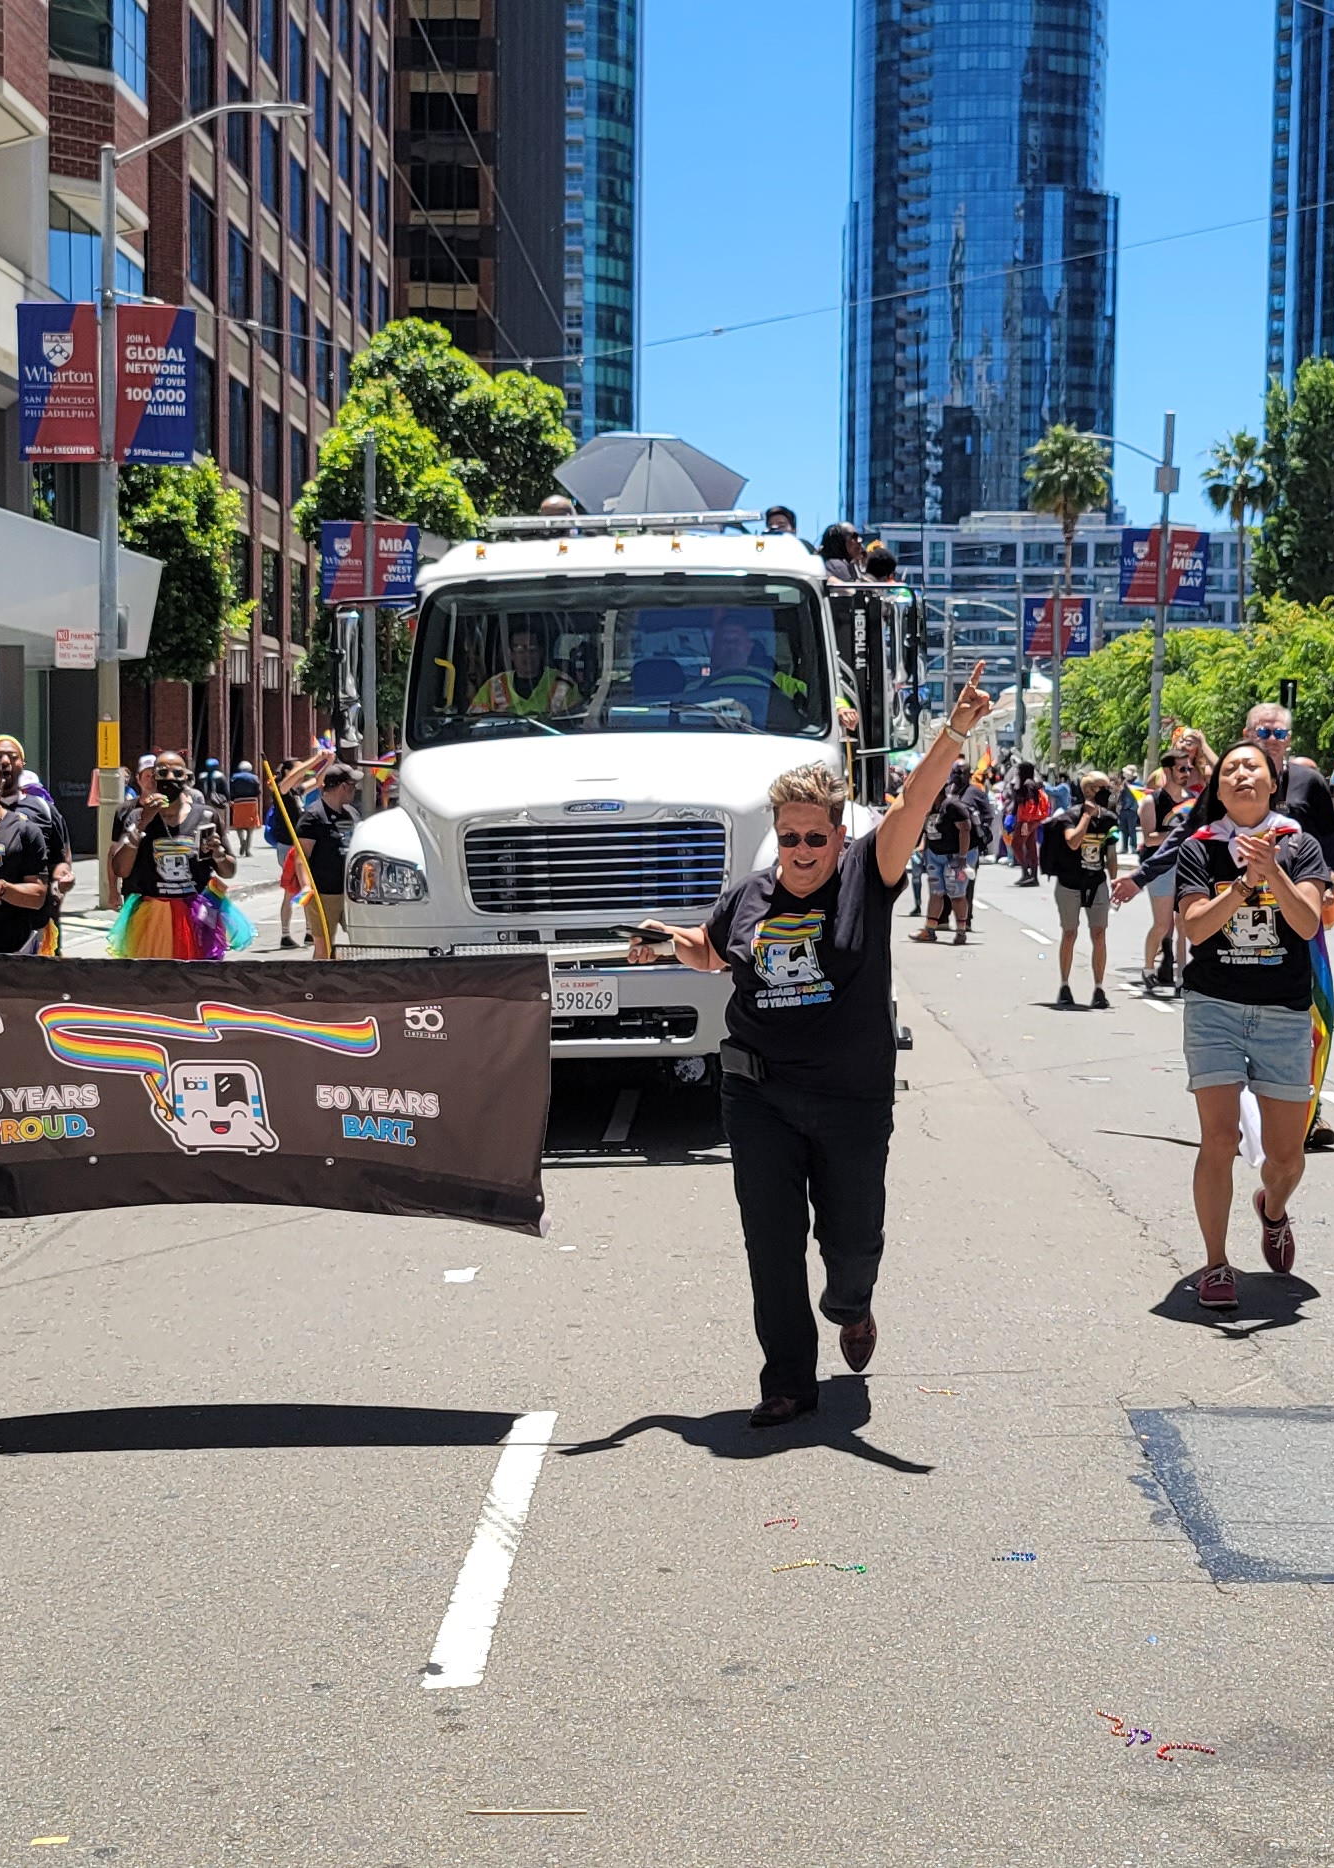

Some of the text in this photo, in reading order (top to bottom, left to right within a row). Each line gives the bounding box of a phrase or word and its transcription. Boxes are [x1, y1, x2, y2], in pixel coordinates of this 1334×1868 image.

[126, 334, 151, 343] JOIN A
[125, 345, 186, 362] GLOBAL
[25, 365, 94, 383] Wharton
[125, 362, 186, 375] NETWORK
[154, 377, 186, 386] OF OVER
[25, 396, 95, 405] SAN FRANCISCO
[125, 387, 186, 403] 100,000
[25, 409, 95, 418] PHILADELPHIA
[146, 404, 186, 416] ALUMNI
[25, 445, 95, 454] MBA for EXECUTIVES
[378, 538, 413, 552] MBA
[387, 565, 412, 574] WEST
[1172, 557, 1204, 570] MBA
[382, 574, 412, 583] COAST
[1179, 575, 1202, 587] BAY
[1063, 612, 1083, 626] 20
[57, 630, 69, 640] NO
[1074, 633, 1086, 642] SF
[767, 986, 796, 997] YEARS
[551, 991, 613, 1010] 598269
[769, 996, 801, 1008] YEARS
[405, 1006, 444, 1032] 50
[2, 1084, 100, 1112] YEARS
[316, 1084, 440, 1118] 50 YEARS
[341, 1114, 417, 1147] BART.
